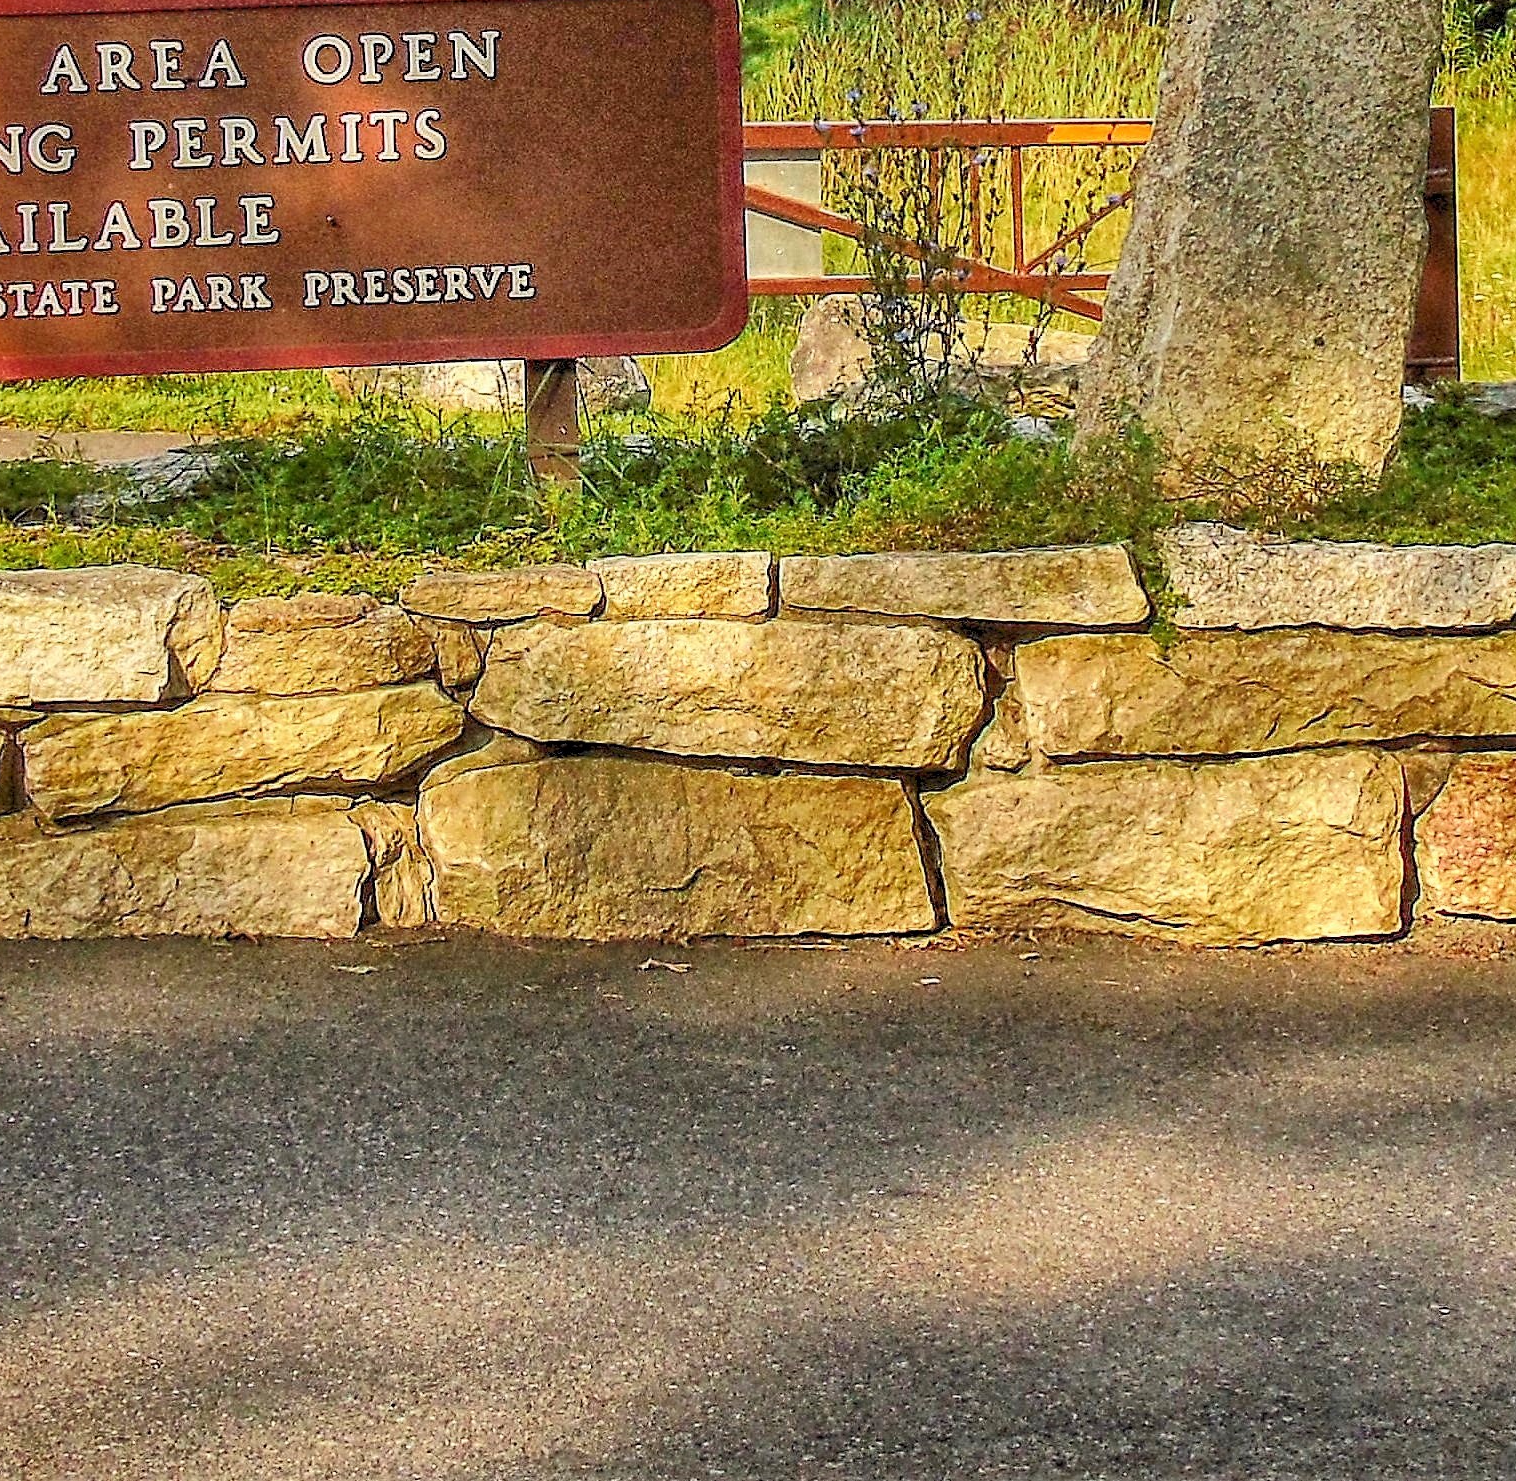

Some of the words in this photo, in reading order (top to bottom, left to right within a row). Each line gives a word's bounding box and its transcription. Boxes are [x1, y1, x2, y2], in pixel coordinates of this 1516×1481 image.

[41, 39, 246, 93] AREA
[303, 30, 500, 84] OPEN
[129, 110, 445, 169] PERMITS
[151, 275, 272, 312] PARK
[303, 264, 535, 307] PRESERVE
